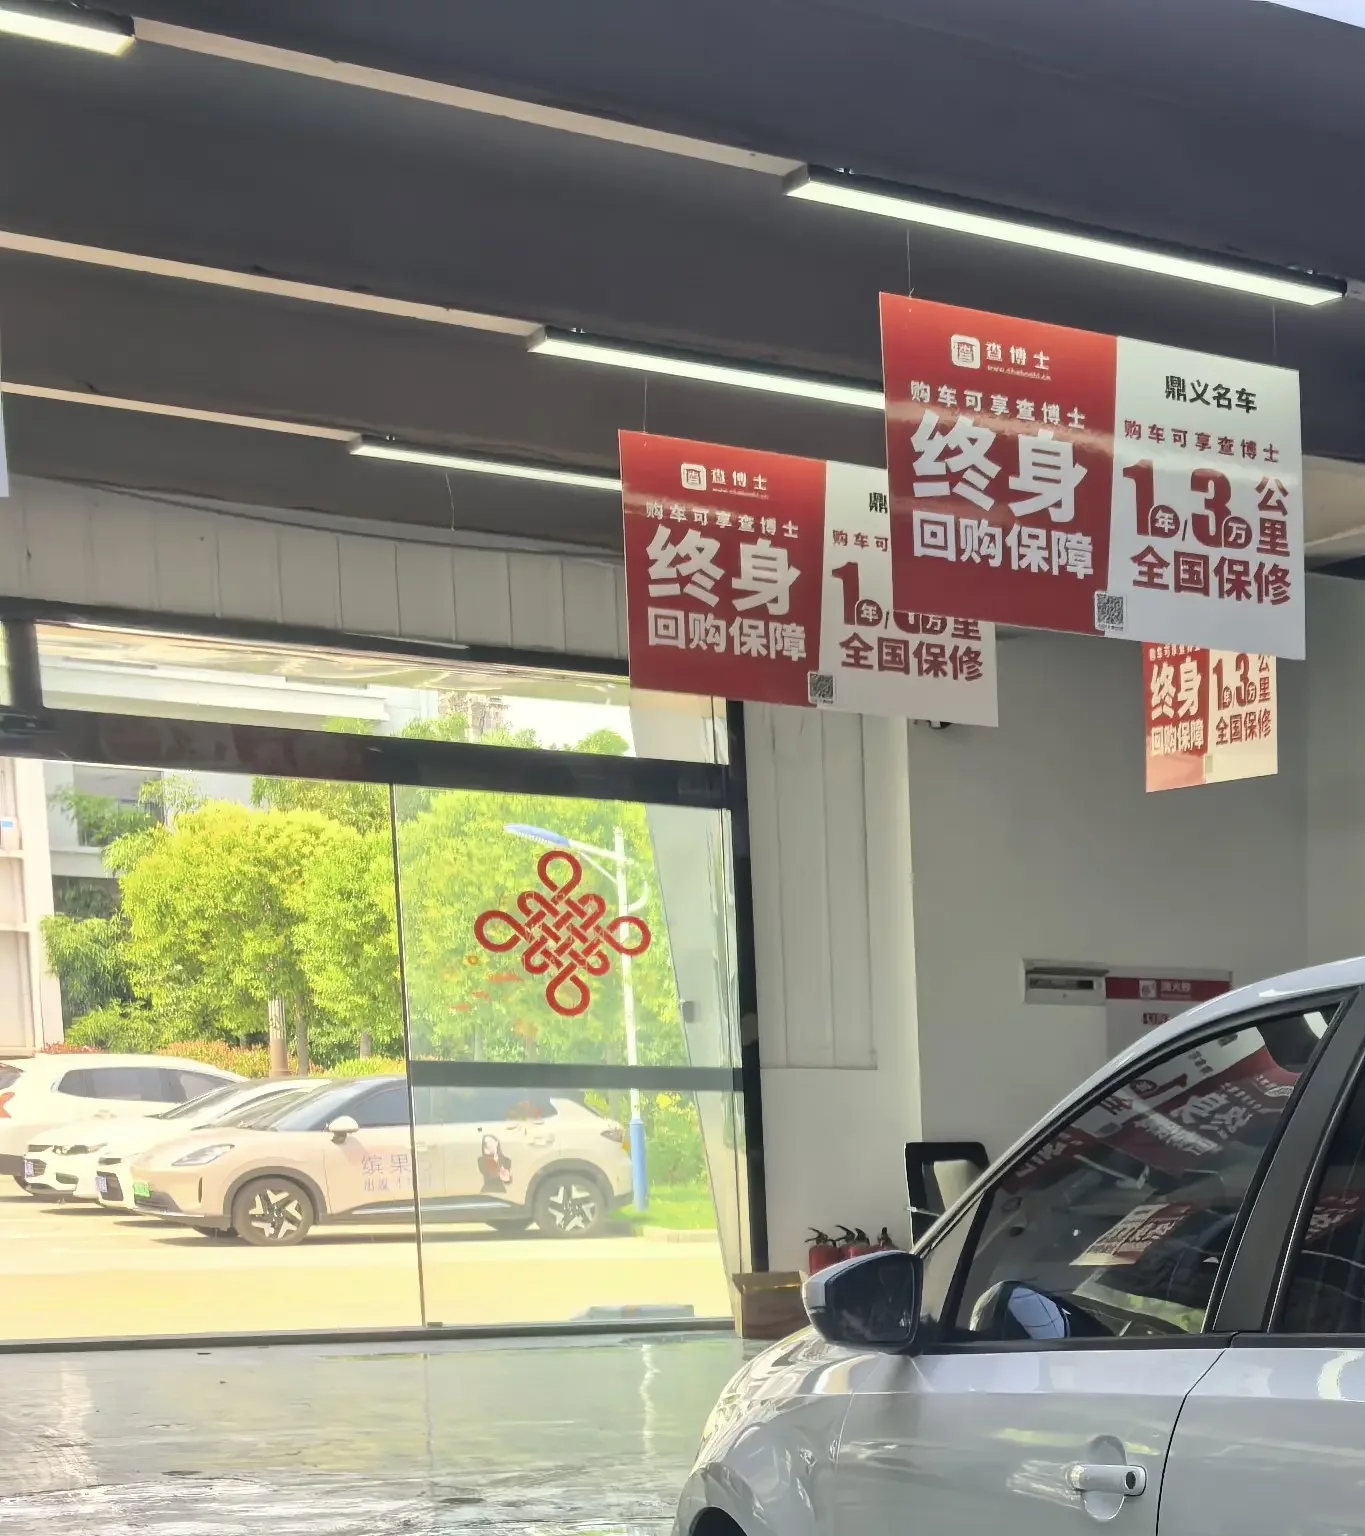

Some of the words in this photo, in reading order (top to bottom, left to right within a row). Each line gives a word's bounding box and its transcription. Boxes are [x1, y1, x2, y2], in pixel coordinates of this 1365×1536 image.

[986, 343, 1050, 370] 查博士
[910, 381, 1086, 430] 购车可享查博士
[1166, 375, 1259, 415] 鼎义名车
[910, 409, 1088, 523] 终身
[1124, 419, 1280, 464] 购车可享查博士
[646, 501, 799, 539] 购车可享查博士
[911, 509, 1094, 579] 回购保障
[645, 524, 802, 616] 终身
[1129, 544, 1292, 606] 全国保修
[646, 606, 807, 662] 回购保障
[838, 631, 982, 682] 全国保修
[1149, 656, 1202, 721] 终身
[1150, 717, 1204, 757] 回购保障
[1214, 707, 1272, 746] 全国保修
